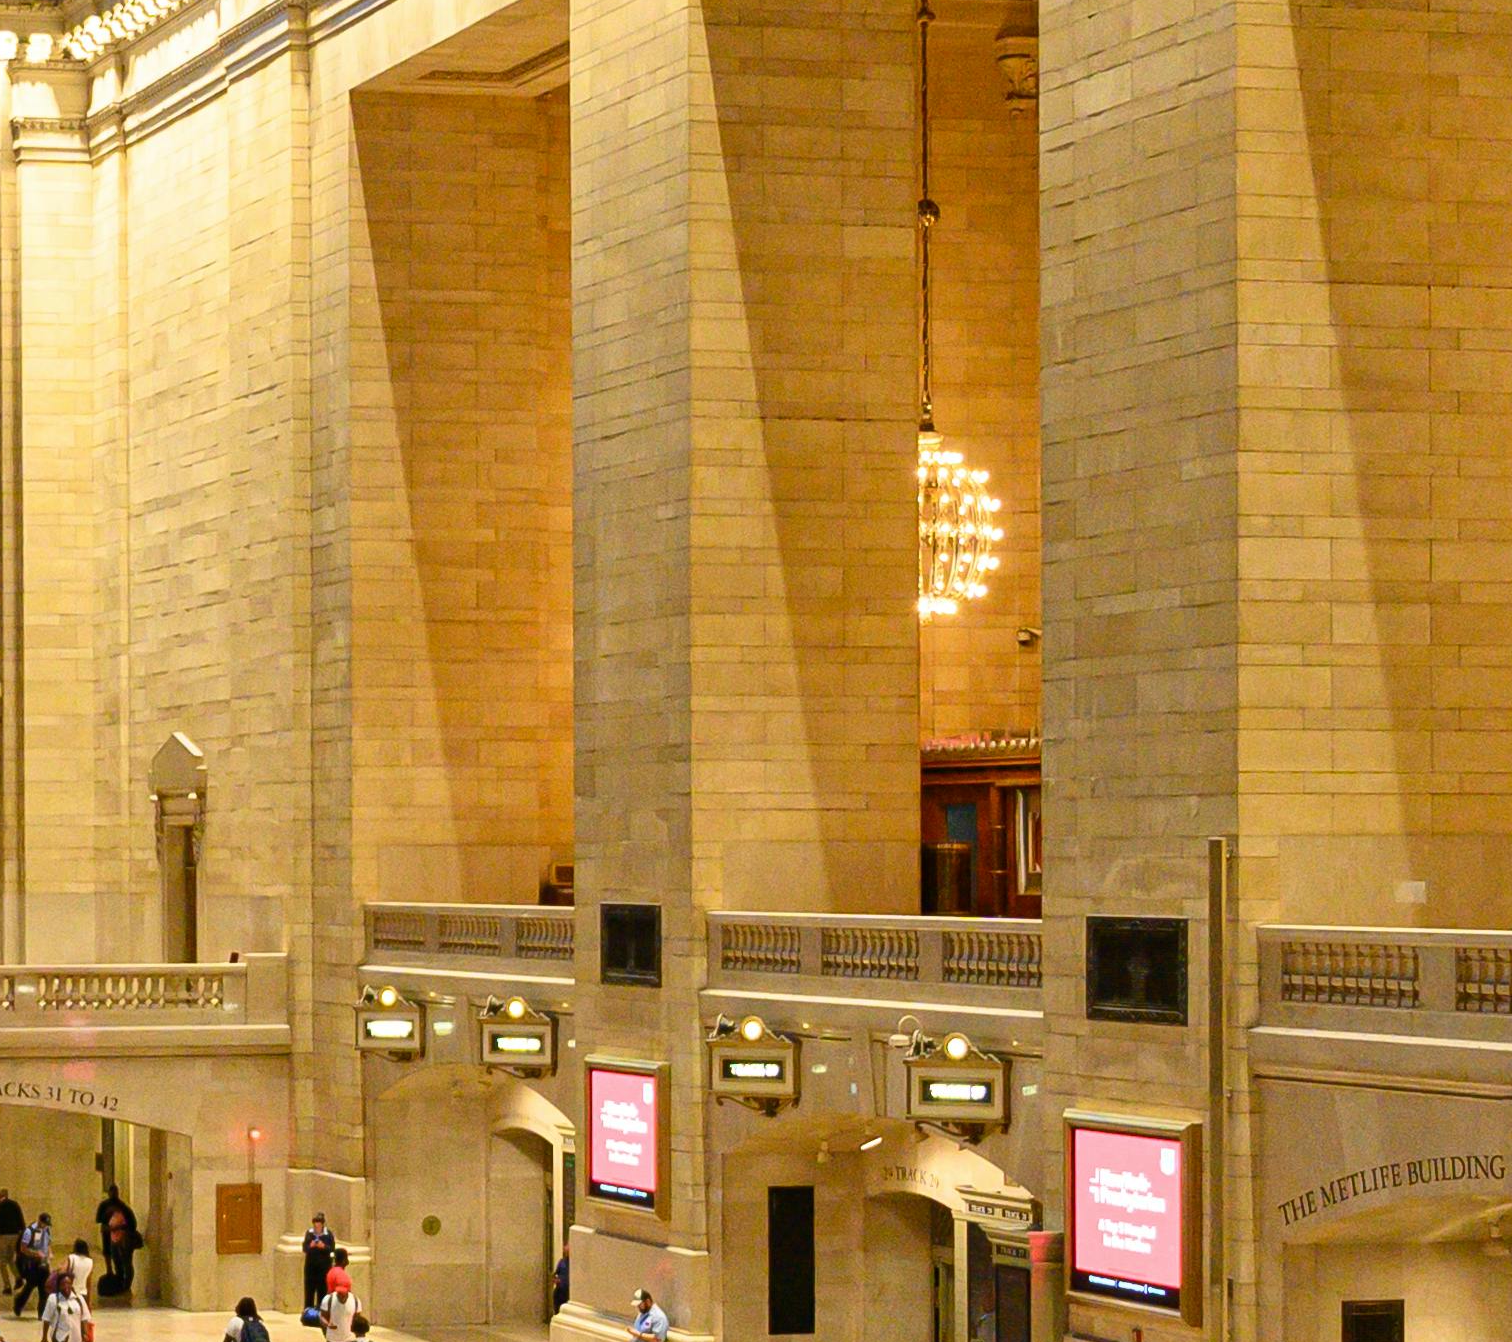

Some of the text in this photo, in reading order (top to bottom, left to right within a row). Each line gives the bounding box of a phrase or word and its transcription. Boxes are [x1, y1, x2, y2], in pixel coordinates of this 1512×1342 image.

[44, 1085, 62, 1102] 31
[69, 1089, 95, 1108] TO
[99, 1095, 119, 1112] 42
[895, 1165, 927, 1185] TRACK
[1278, 1154, 1506, 1226] THE METLIFE BUILDING
